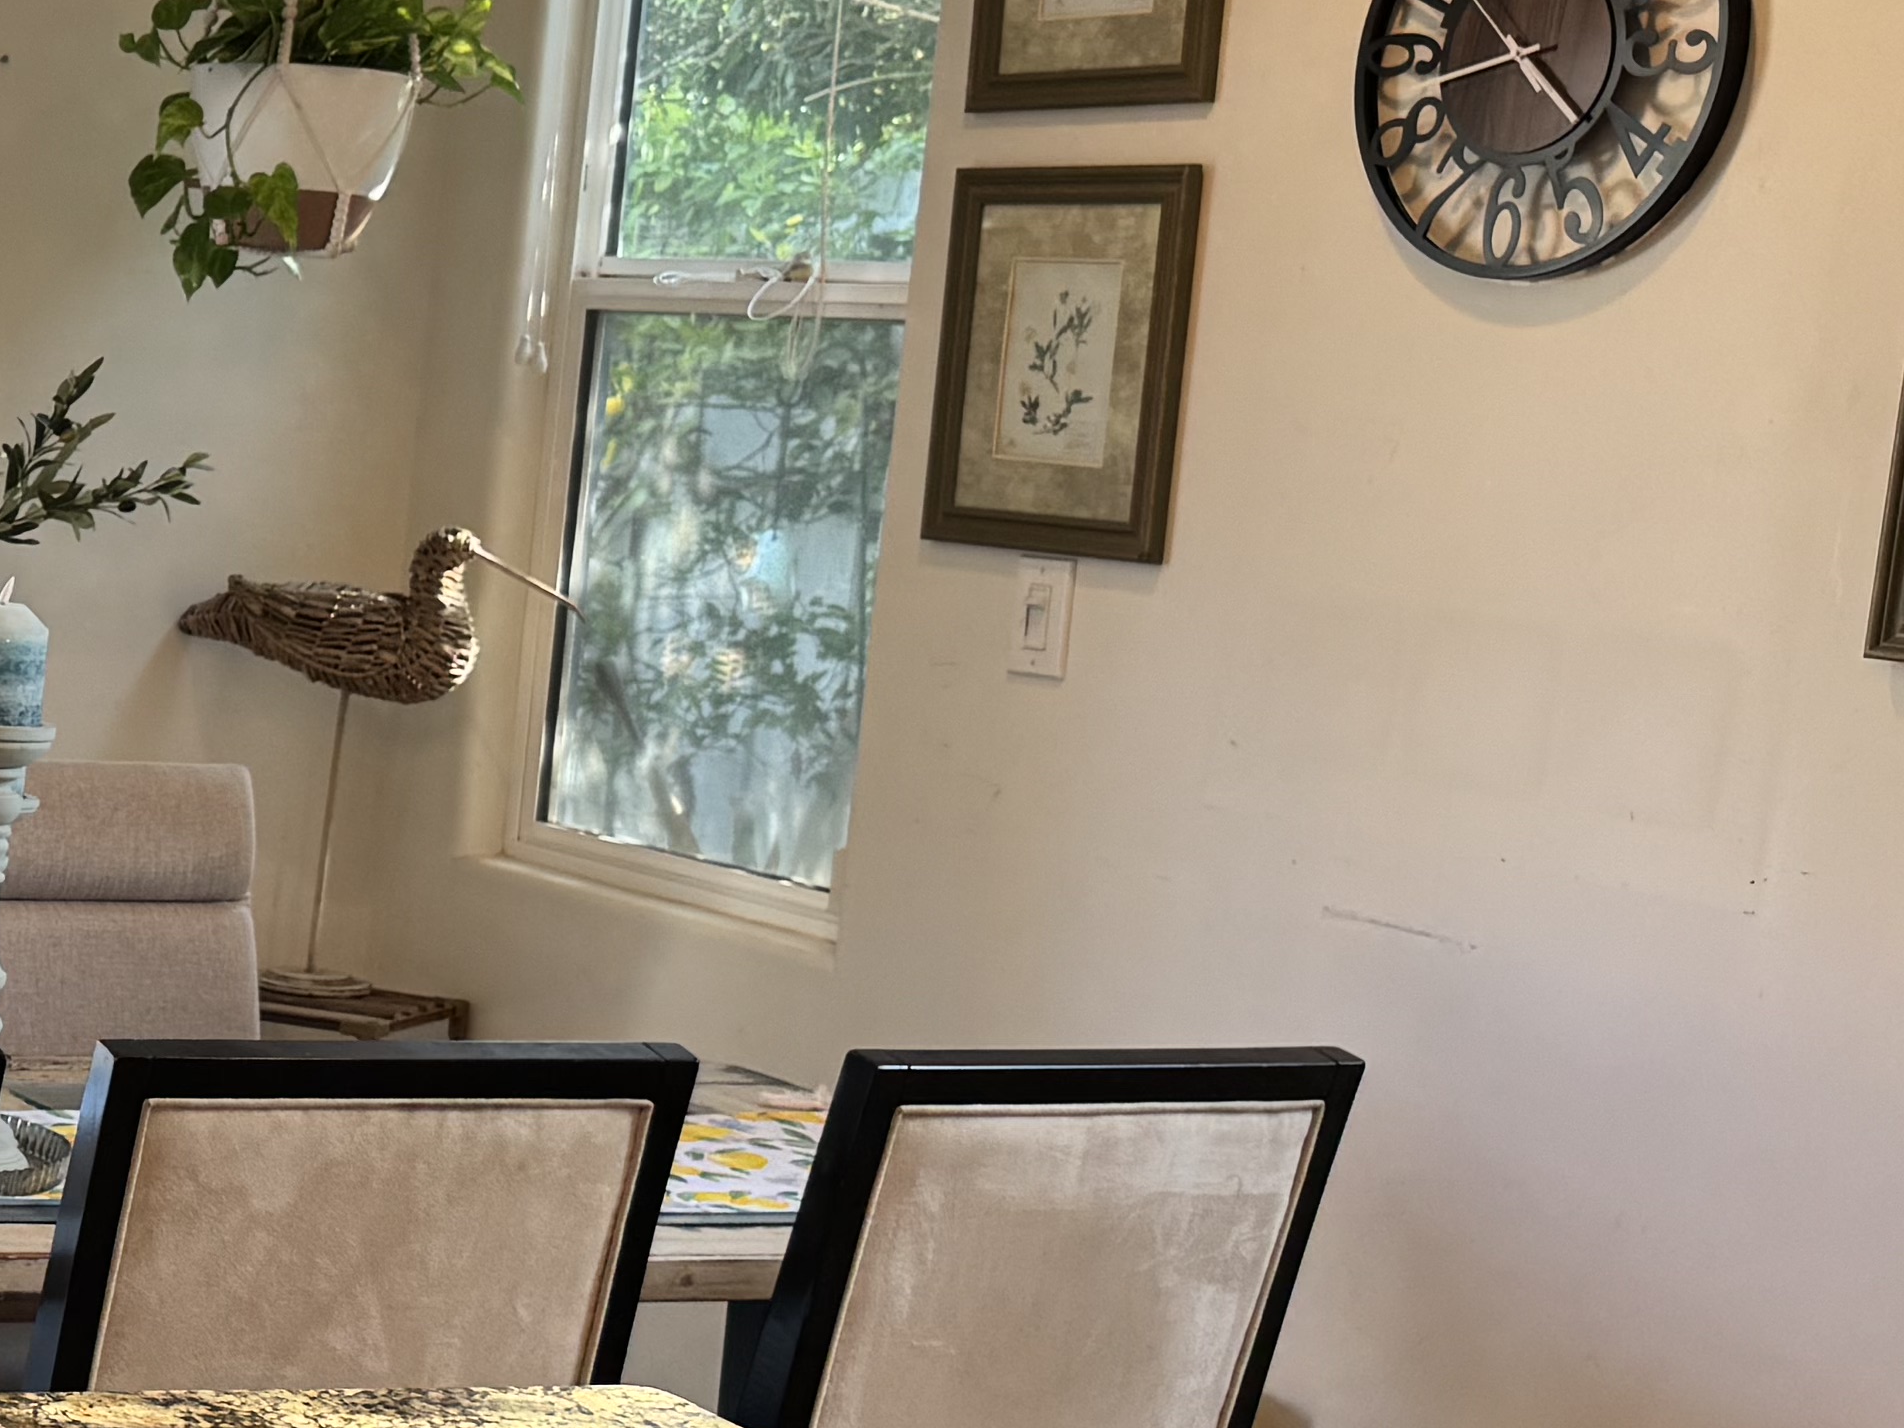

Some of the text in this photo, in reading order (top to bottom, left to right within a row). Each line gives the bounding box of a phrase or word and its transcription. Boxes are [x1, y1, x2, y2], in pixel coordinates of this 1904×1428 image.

[1366, 33, 1443, 76] 9
[1368, 97, 1446, 172] 8
[1604, 106, 1688, 179] 4
[1483, 167, 1527, 267] 6
